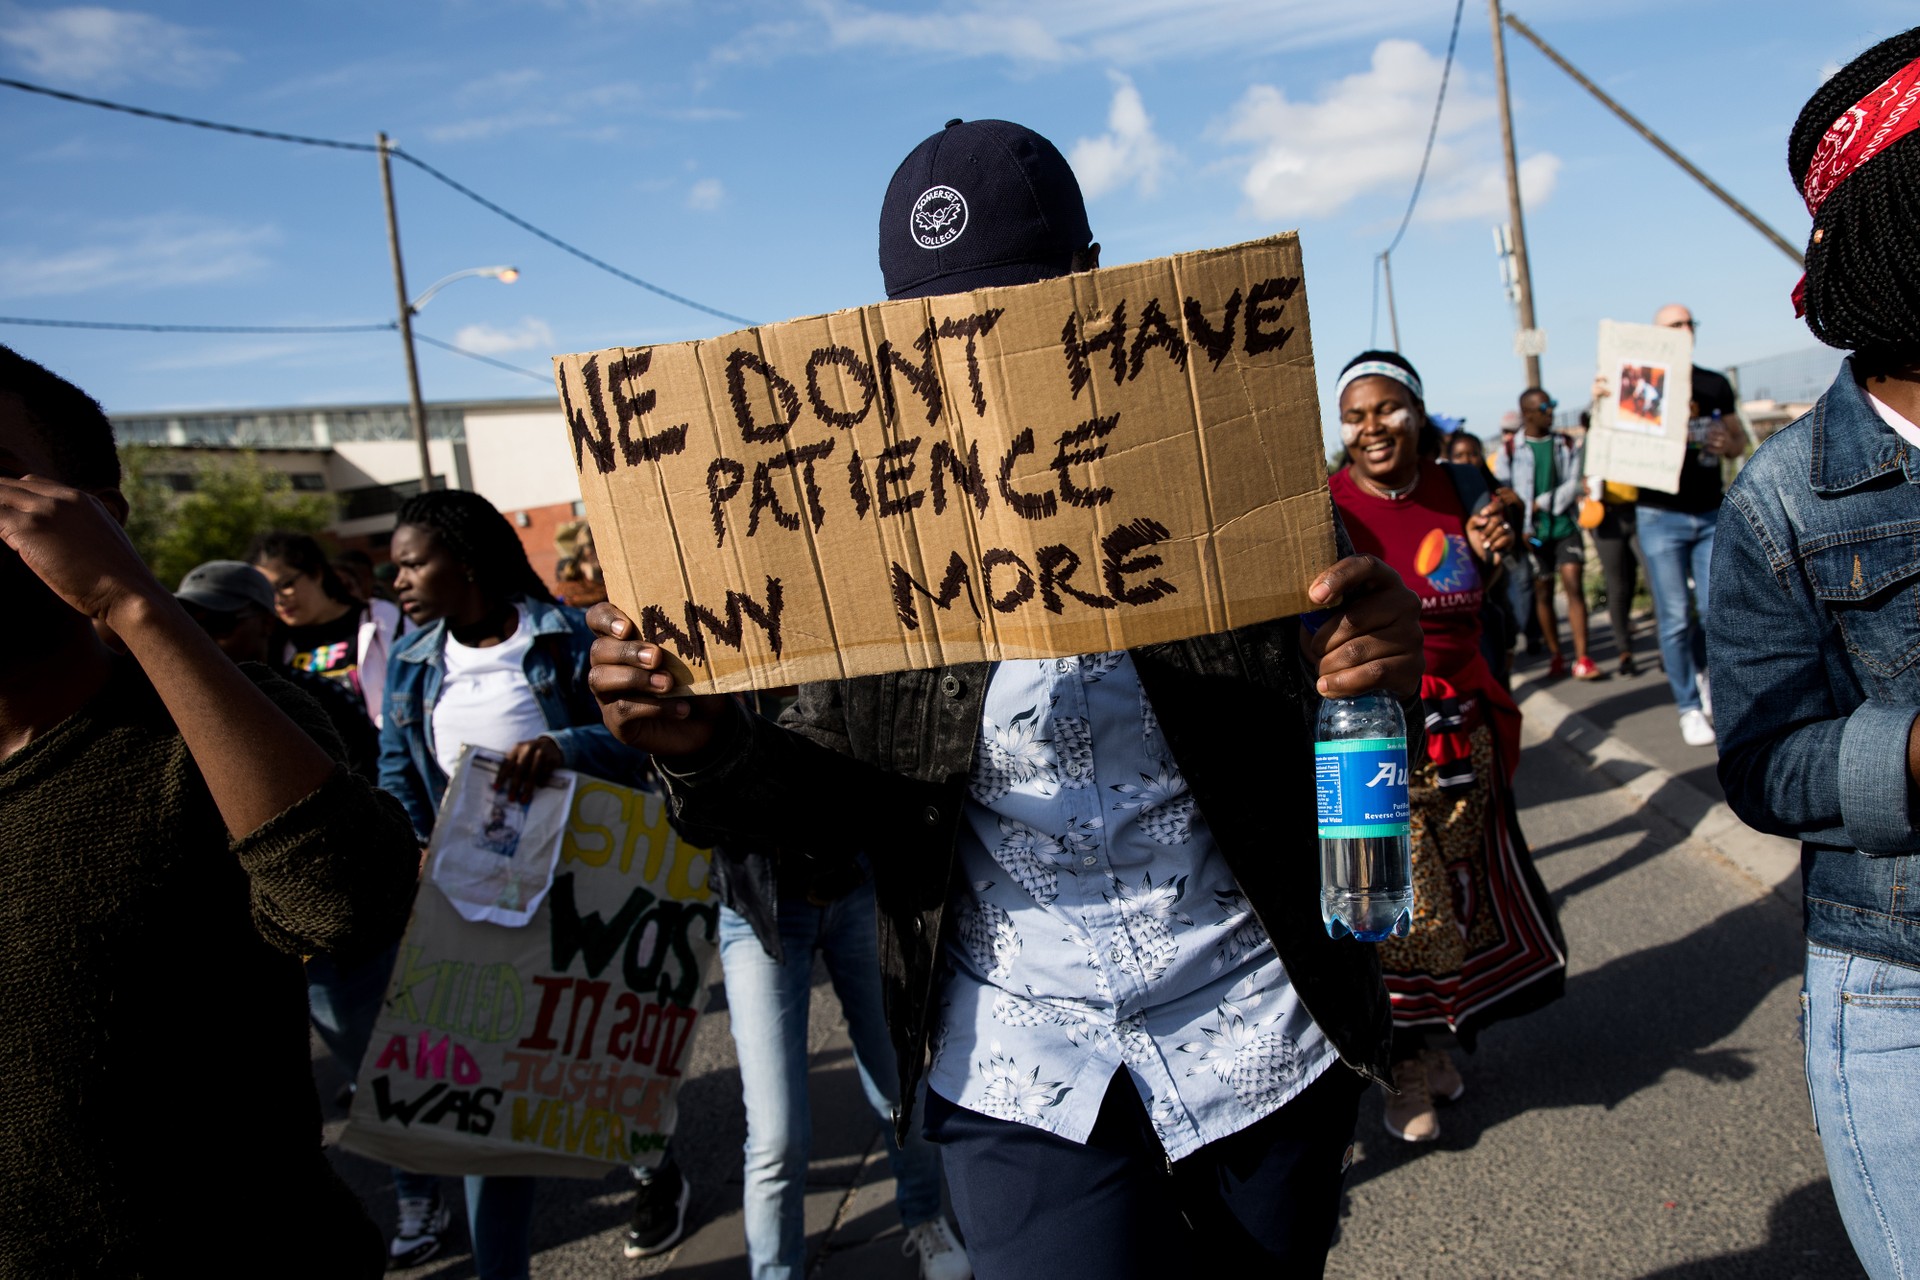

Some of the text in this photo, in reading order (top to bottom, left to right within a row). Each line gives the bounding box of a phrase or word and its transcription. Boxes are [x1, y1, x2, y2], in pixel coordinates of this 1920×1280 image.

[918, 190, 959, 211] SOMERSET
[921, 227, 957, 245] COLLEGE
[560, 277, 1301, 475] WE DONT HAVE
[706, 412, 1120, 548] PATIENCE
[641, 517, 1178, 667] ANY MORE
[1364, 812, 1393, 820] Reverse
[375, 1030, 482, 1085] AND
[607, 993, 697, 1076] 2017
[371, 1075, 503, 1135] WAS
[511, 1098, 632, 1161] NEVER
